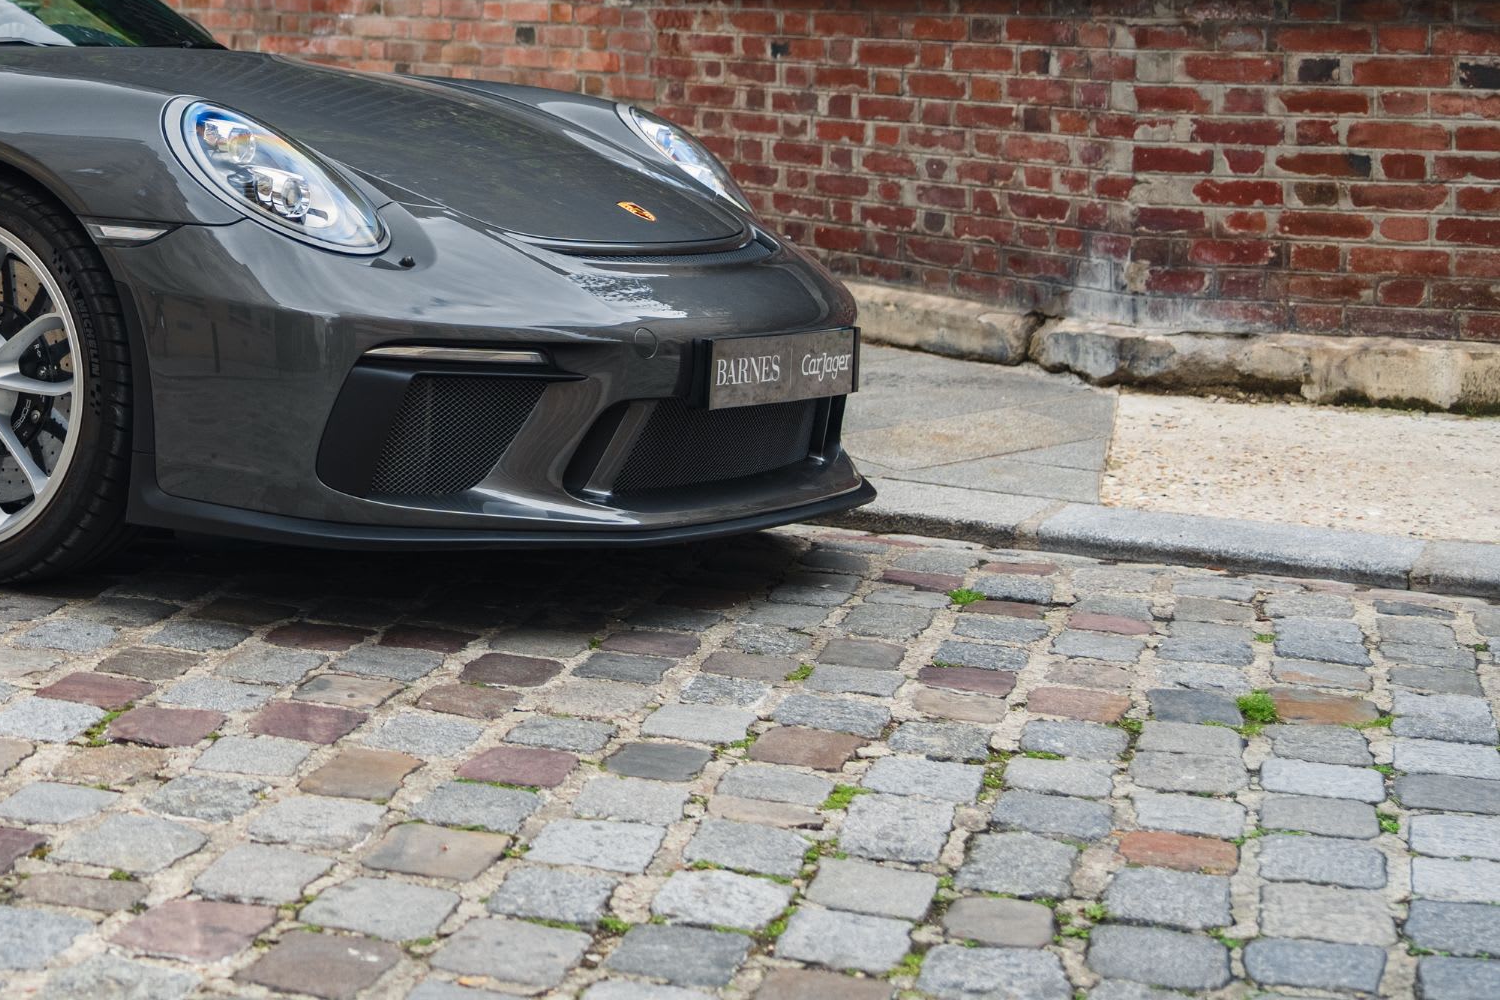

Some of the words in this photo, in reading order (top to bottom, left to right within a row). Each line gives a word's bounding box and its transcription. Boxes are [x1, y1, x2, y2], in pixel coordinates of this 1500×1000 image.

[76, 297, 101, 378] MICHELIN
[715, 355, 781, 386] BARNES
[801, 352, 852, 382] CarJager
